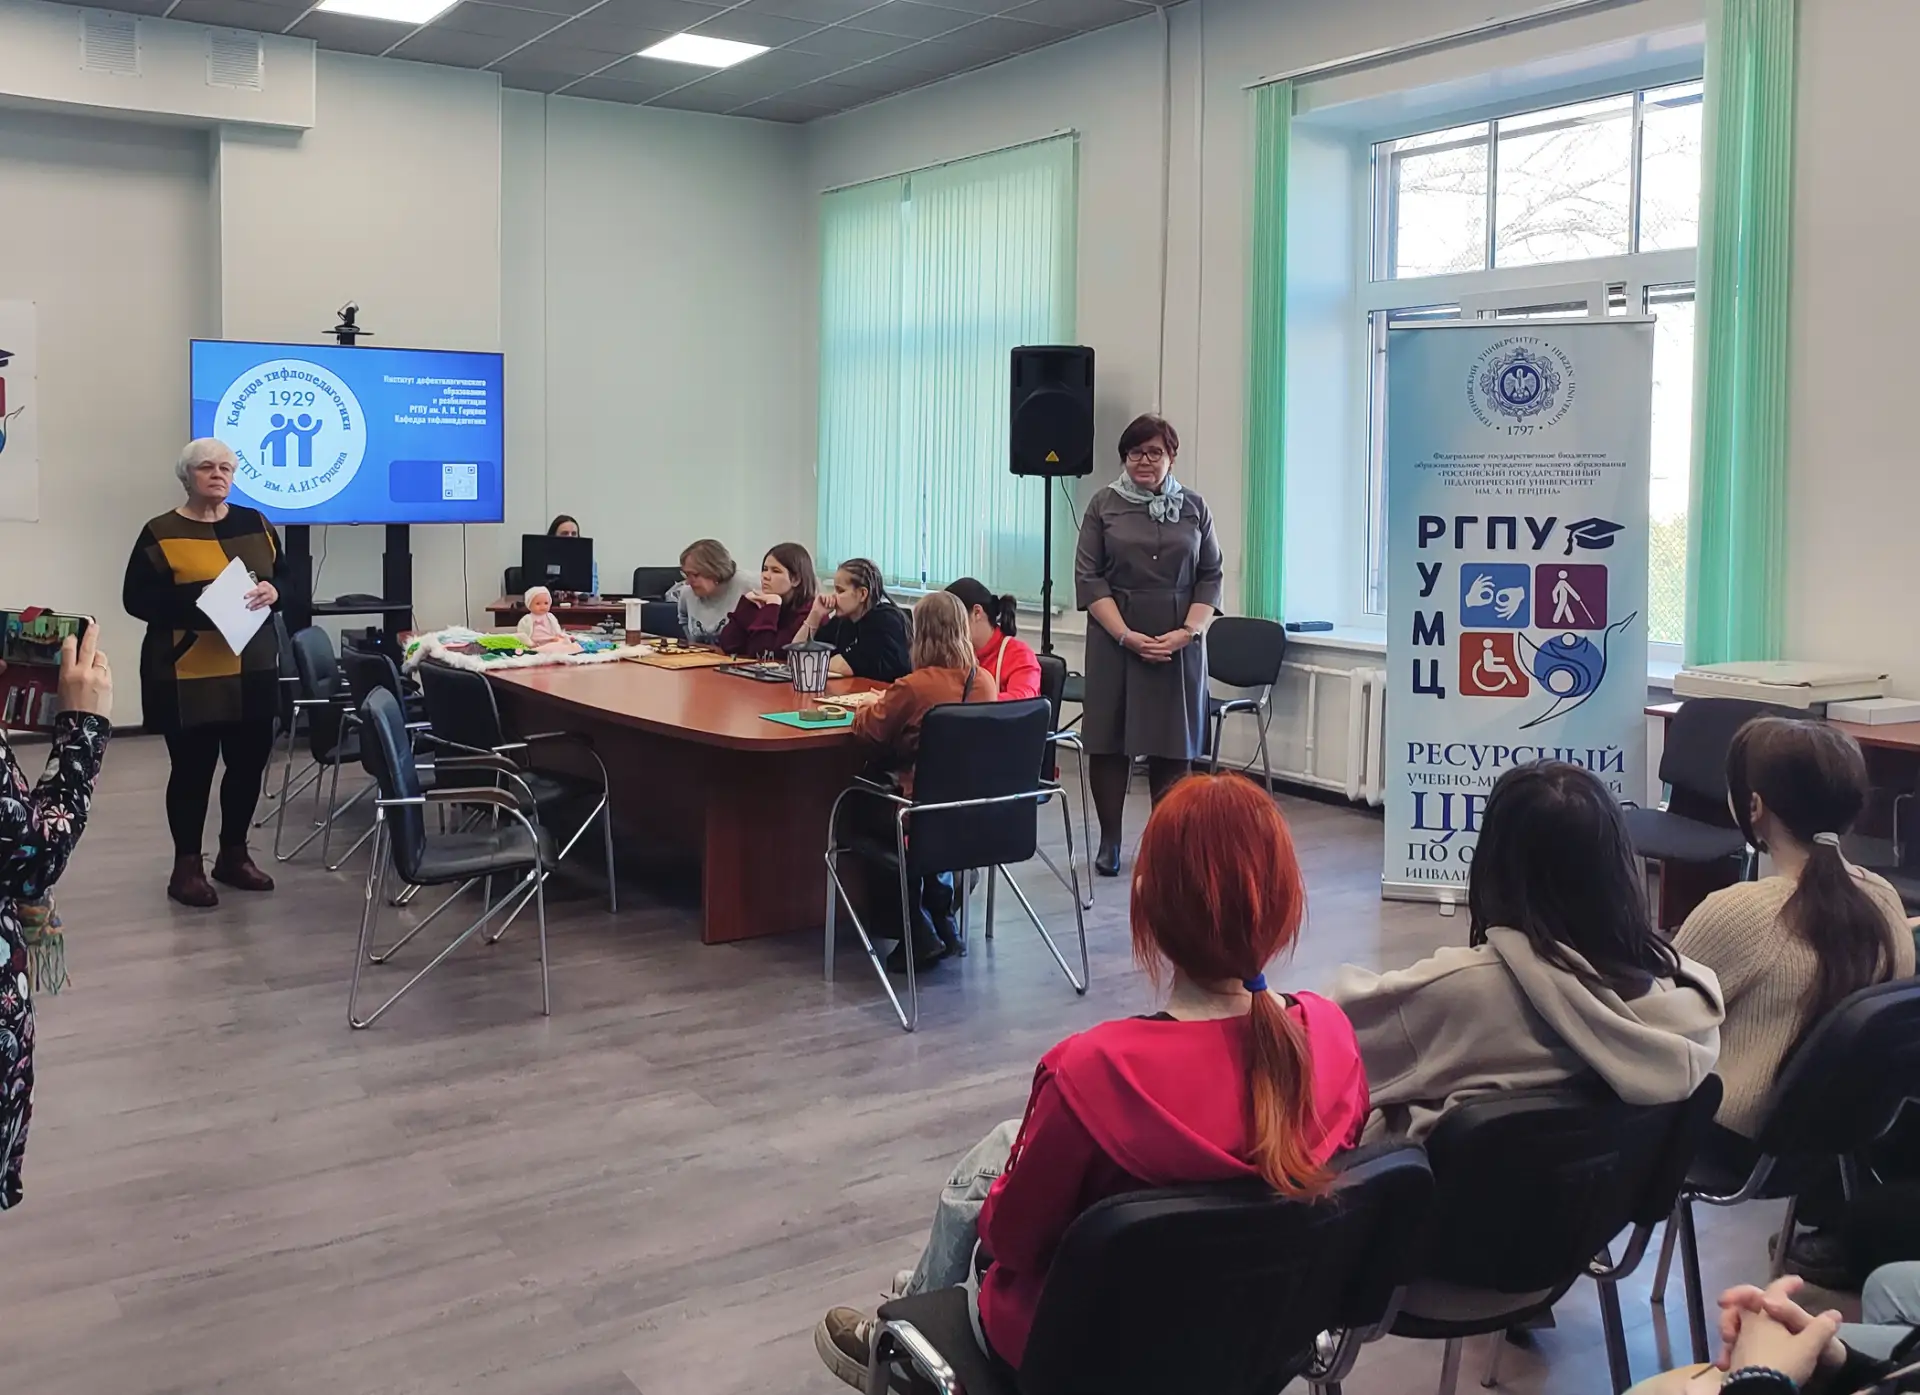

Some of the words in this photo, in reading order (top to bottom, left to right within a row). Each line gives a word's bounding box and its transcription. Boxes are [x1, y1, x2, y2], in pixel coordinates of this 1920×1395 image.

[1477, 336, 1541, 362] УНИВЕРСИТЕТ
[1551, 346, 1575, 377] HERZEN
[227, 378, 264, 428] Кафедра
[264, 367, 352, 431] тифлопедагогики
[269, 391, 316, 407] 1929
[1546, 382, 1576, 427] UNIVERSITY
[409, 405, 428, 414] РГПУ
[458, 406, 487, 416] Герцена
[394, 415, 426, 425] Кафедра
[1507, 425, 1535, 436] 1797
[1433, 452, 1485, 461] Федеральное
[1487, 453, 1556, 461] государственное
[1557, 452, 1607, 460] бюджетное
[1413, 461, 1481, 470] образовательное
[1573, 461, 1627, 469] образования
[1508, 469, 1601, 478] ГОСУДАРСТВЕННЫЙ
[263, 480, 283, 493] им.
[1443, 478, 1527, 487] ПЕДАГОГИЧЕСКИЙ
[1528, 478, 1596, 487] УНИВЕРСИТЕТ
[1418, 515, 1557, 550] РГПУ
[1406, 842, 1448, 863] ПО
